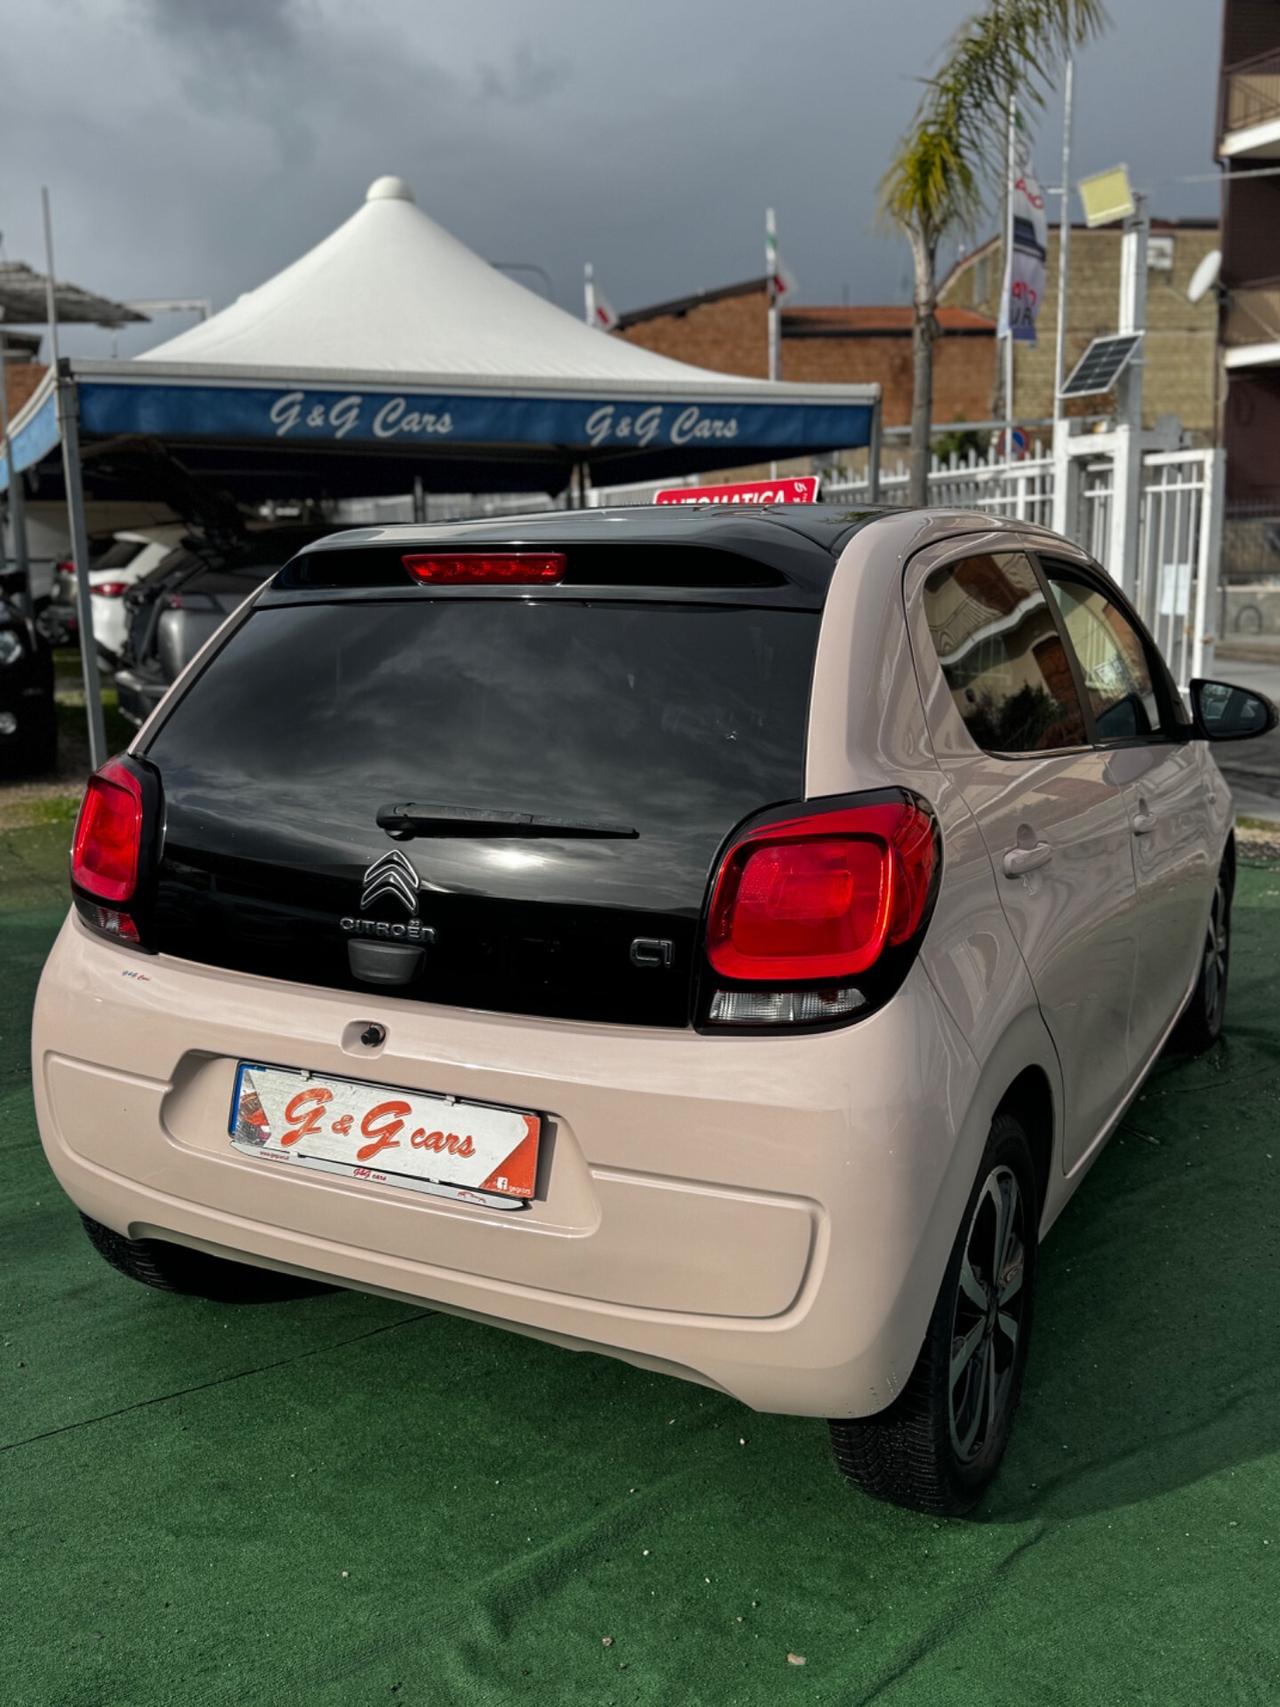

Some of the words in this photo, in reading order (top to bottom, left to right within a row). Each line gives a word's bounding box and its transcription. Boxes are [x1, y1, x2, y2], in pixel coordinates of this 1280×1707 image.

[372, 397, 454, 438] Cars
[669, 406, 739, 445] Cars
[339, 916, 437, 944] CITROËN
[630, 936, 674, 968] C1
[410, 1127, 476, 1158] cars
